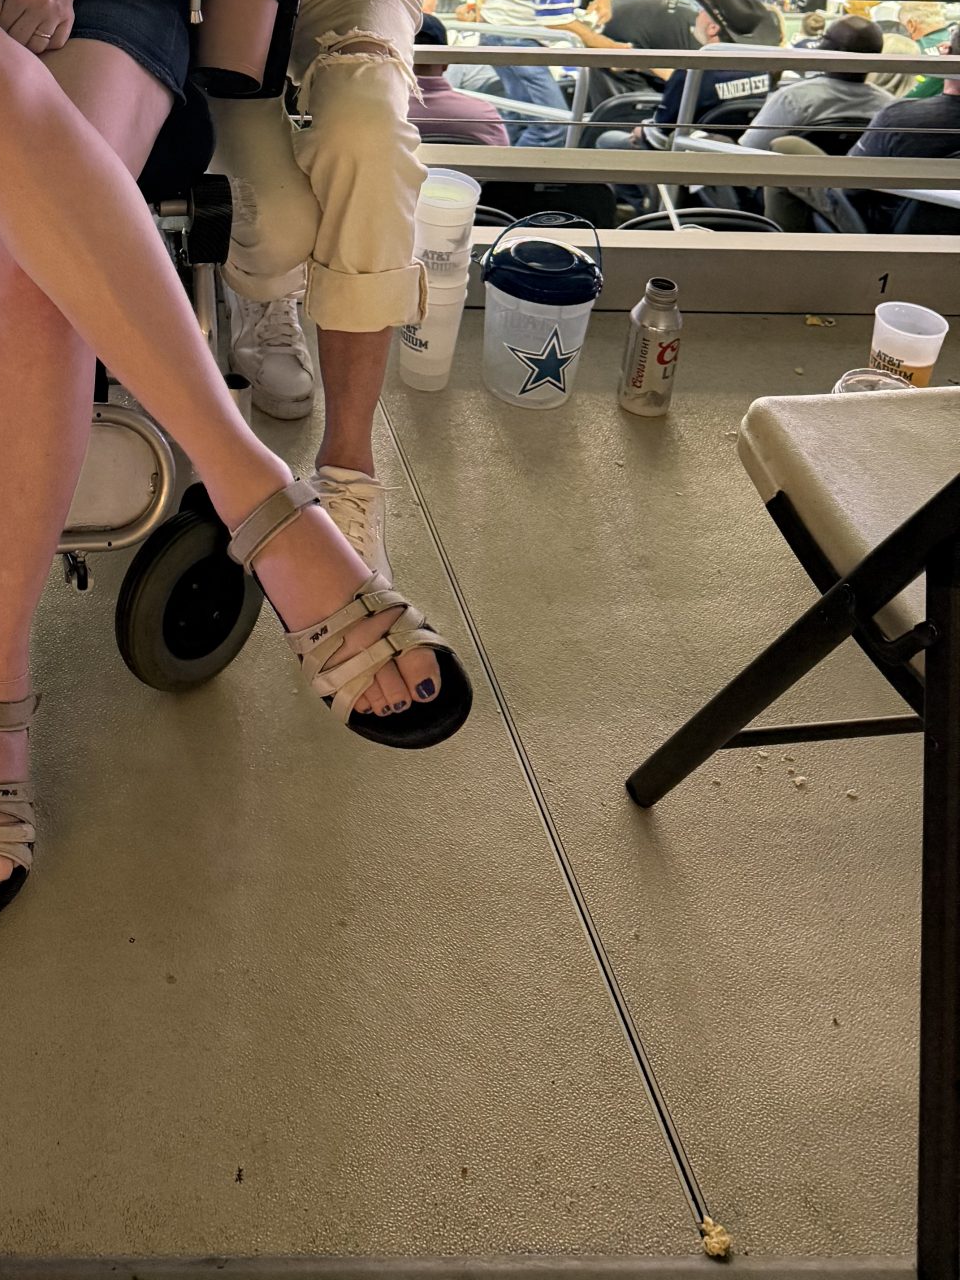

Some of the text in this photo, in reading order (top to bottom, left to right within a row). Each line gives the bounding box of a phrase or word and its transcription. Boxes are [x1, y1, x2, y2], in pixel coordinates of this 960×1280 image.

[421, 248, 453, 262] AT&T
[877, 272, 890, 294] 1
[639, 337, 651, 365] LIGHT
[876, 349, 905, 369] AT&T
